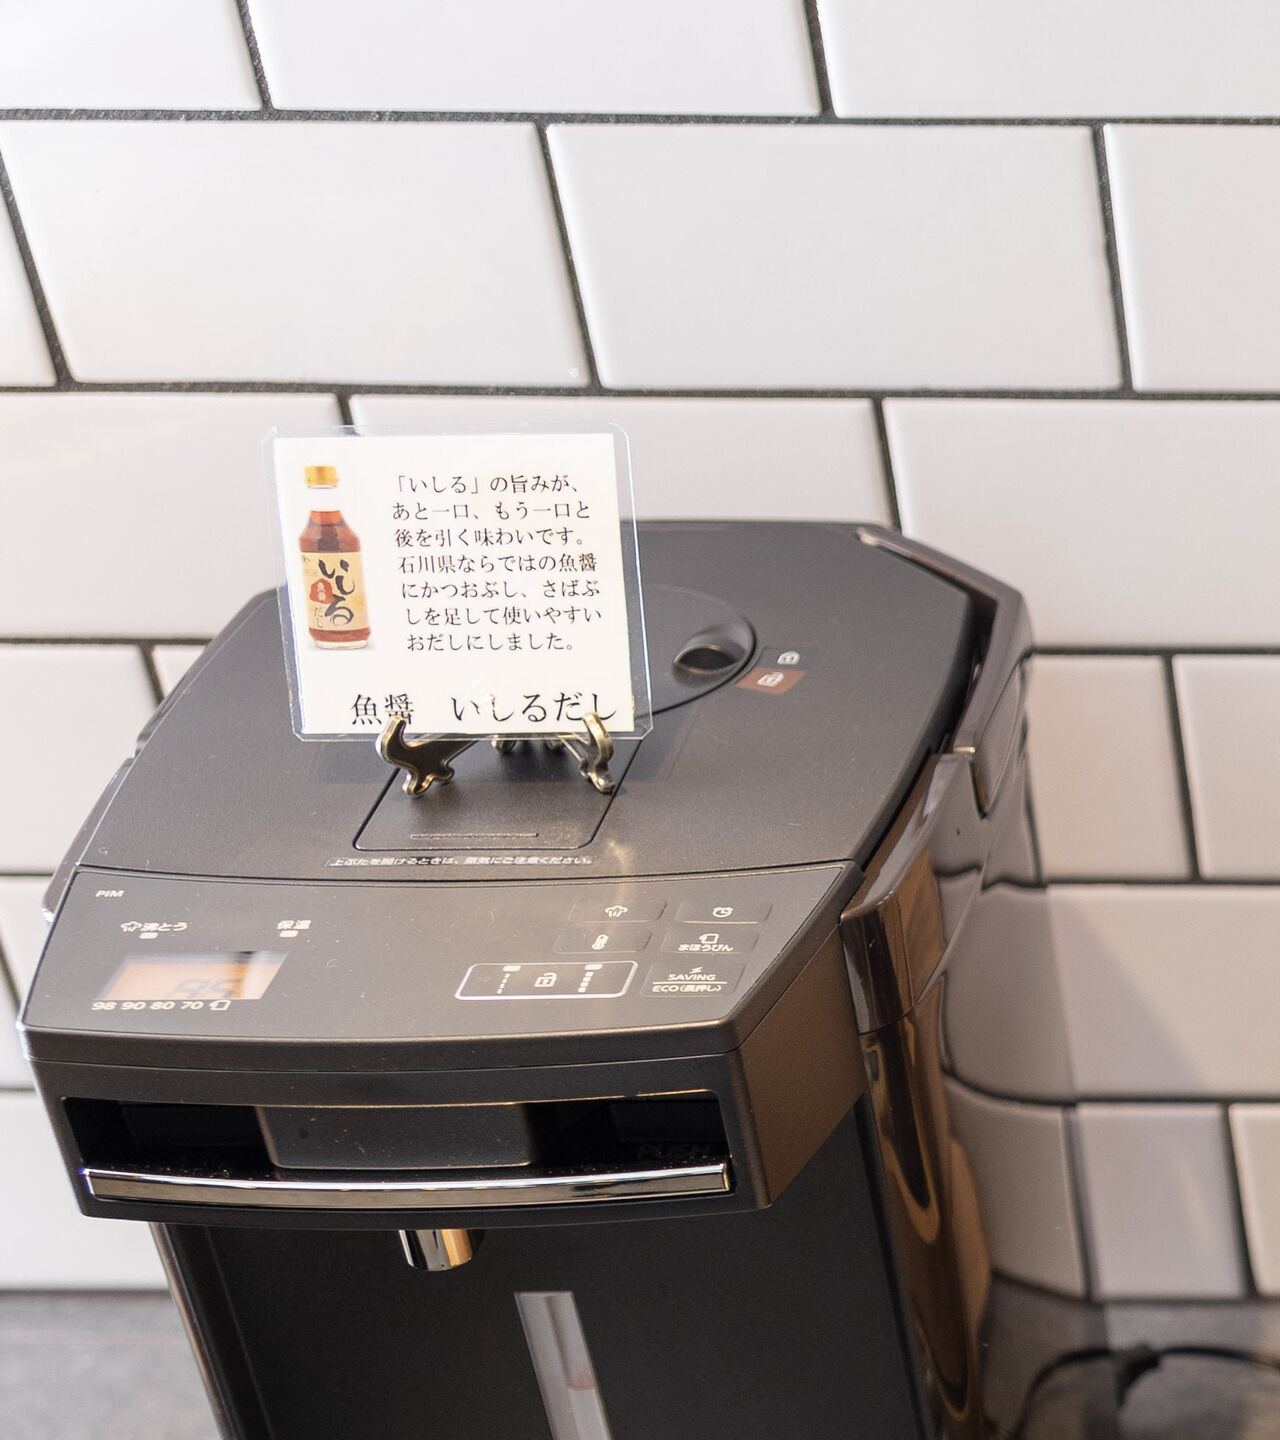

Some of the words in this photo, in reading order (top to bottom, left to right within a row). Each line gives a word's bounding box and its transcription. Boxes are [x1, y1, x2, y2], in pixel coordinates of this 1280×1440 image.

[397, 474, 580, 494] 「いしる」の旨みが、
[392, 501, 591, 520] あと一口、もう一口と
[394, 529, 585, 547] 後を引く味わいです。
[318, 559, 355, 626] いしる
[402, 580, 600, 599] にかつおぶし、さばぶ
[406, 606, 602, 626] しを足して使いやすい
[407, 633, 575, 651] おだしにしました。
[451, 692, 617, 722] いしるだし
[277, 920, 311, 929] 保温
[667, 973, 716, 981] SAVING
[92, 1002, 117, 1011] 98
[121, 1002, 146, 1010] 90
[150, 1002, 175, 1010] 80
[180, 1002, 204, 1010] 70
